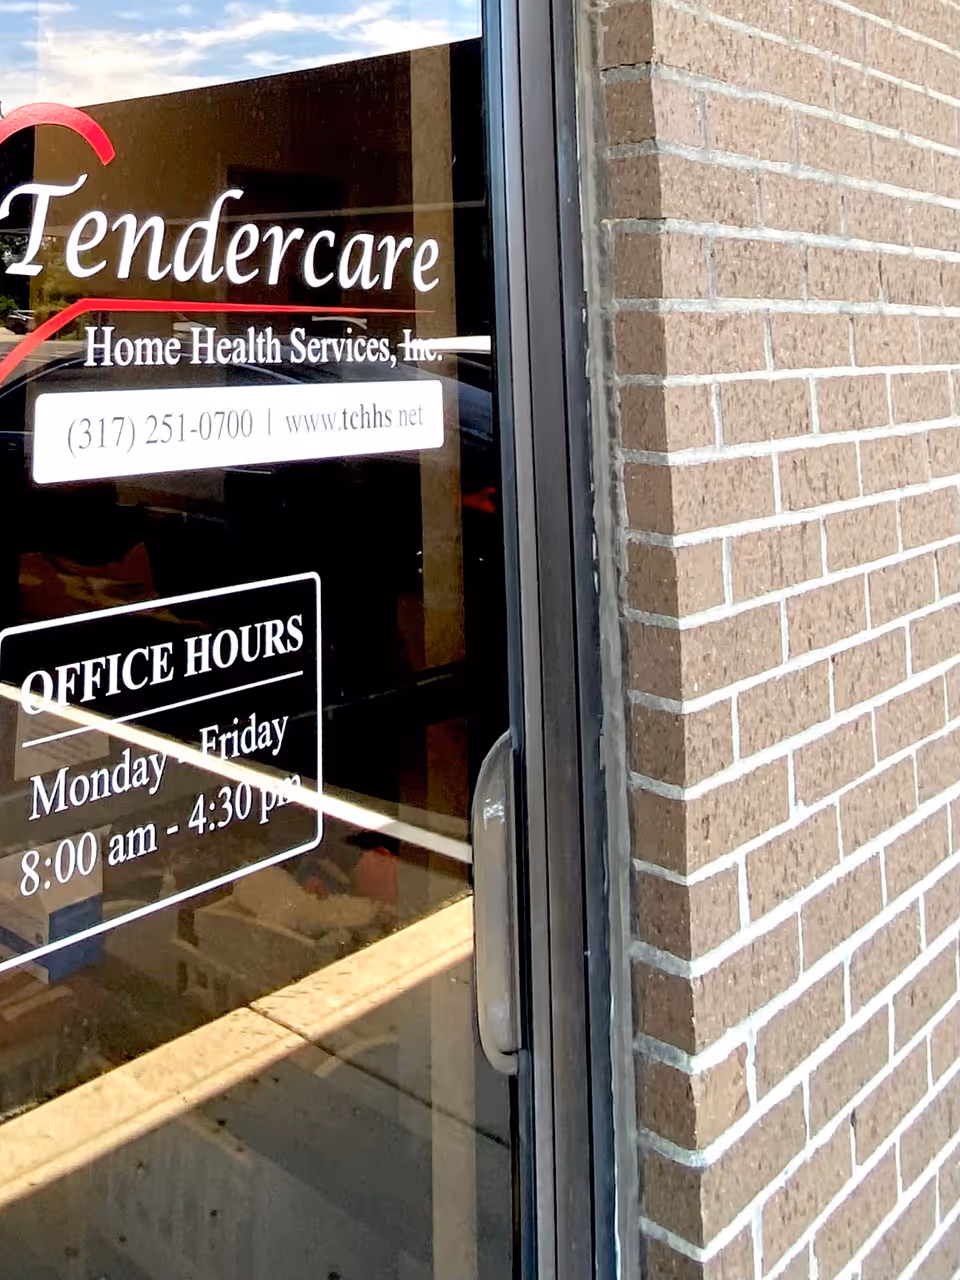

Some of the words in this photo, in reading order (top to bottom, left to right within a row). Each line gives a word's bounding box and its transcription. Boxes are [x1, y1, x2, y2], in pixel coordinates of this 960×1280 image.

[84, 325, 182, 367] Home
[190, 326, 283, 365] Health
[289, 327, 398, 369] Services,
[67, 415, 136, 457] (317)
[144, 408, 254, 446] 251-0700
[285, 402, 425, 434] www.tchhsnet
[19, 642, 173, 716] OFFICE
[184, 614, 304, 678] HOURS
[28, 747, 168, 821] Monday
[199, 712, 289, 763] Friday
[19, 832, 98, 897] 8:00
[108, 821, 158, 867] am
[188, 781, 252, 835] 4:30
